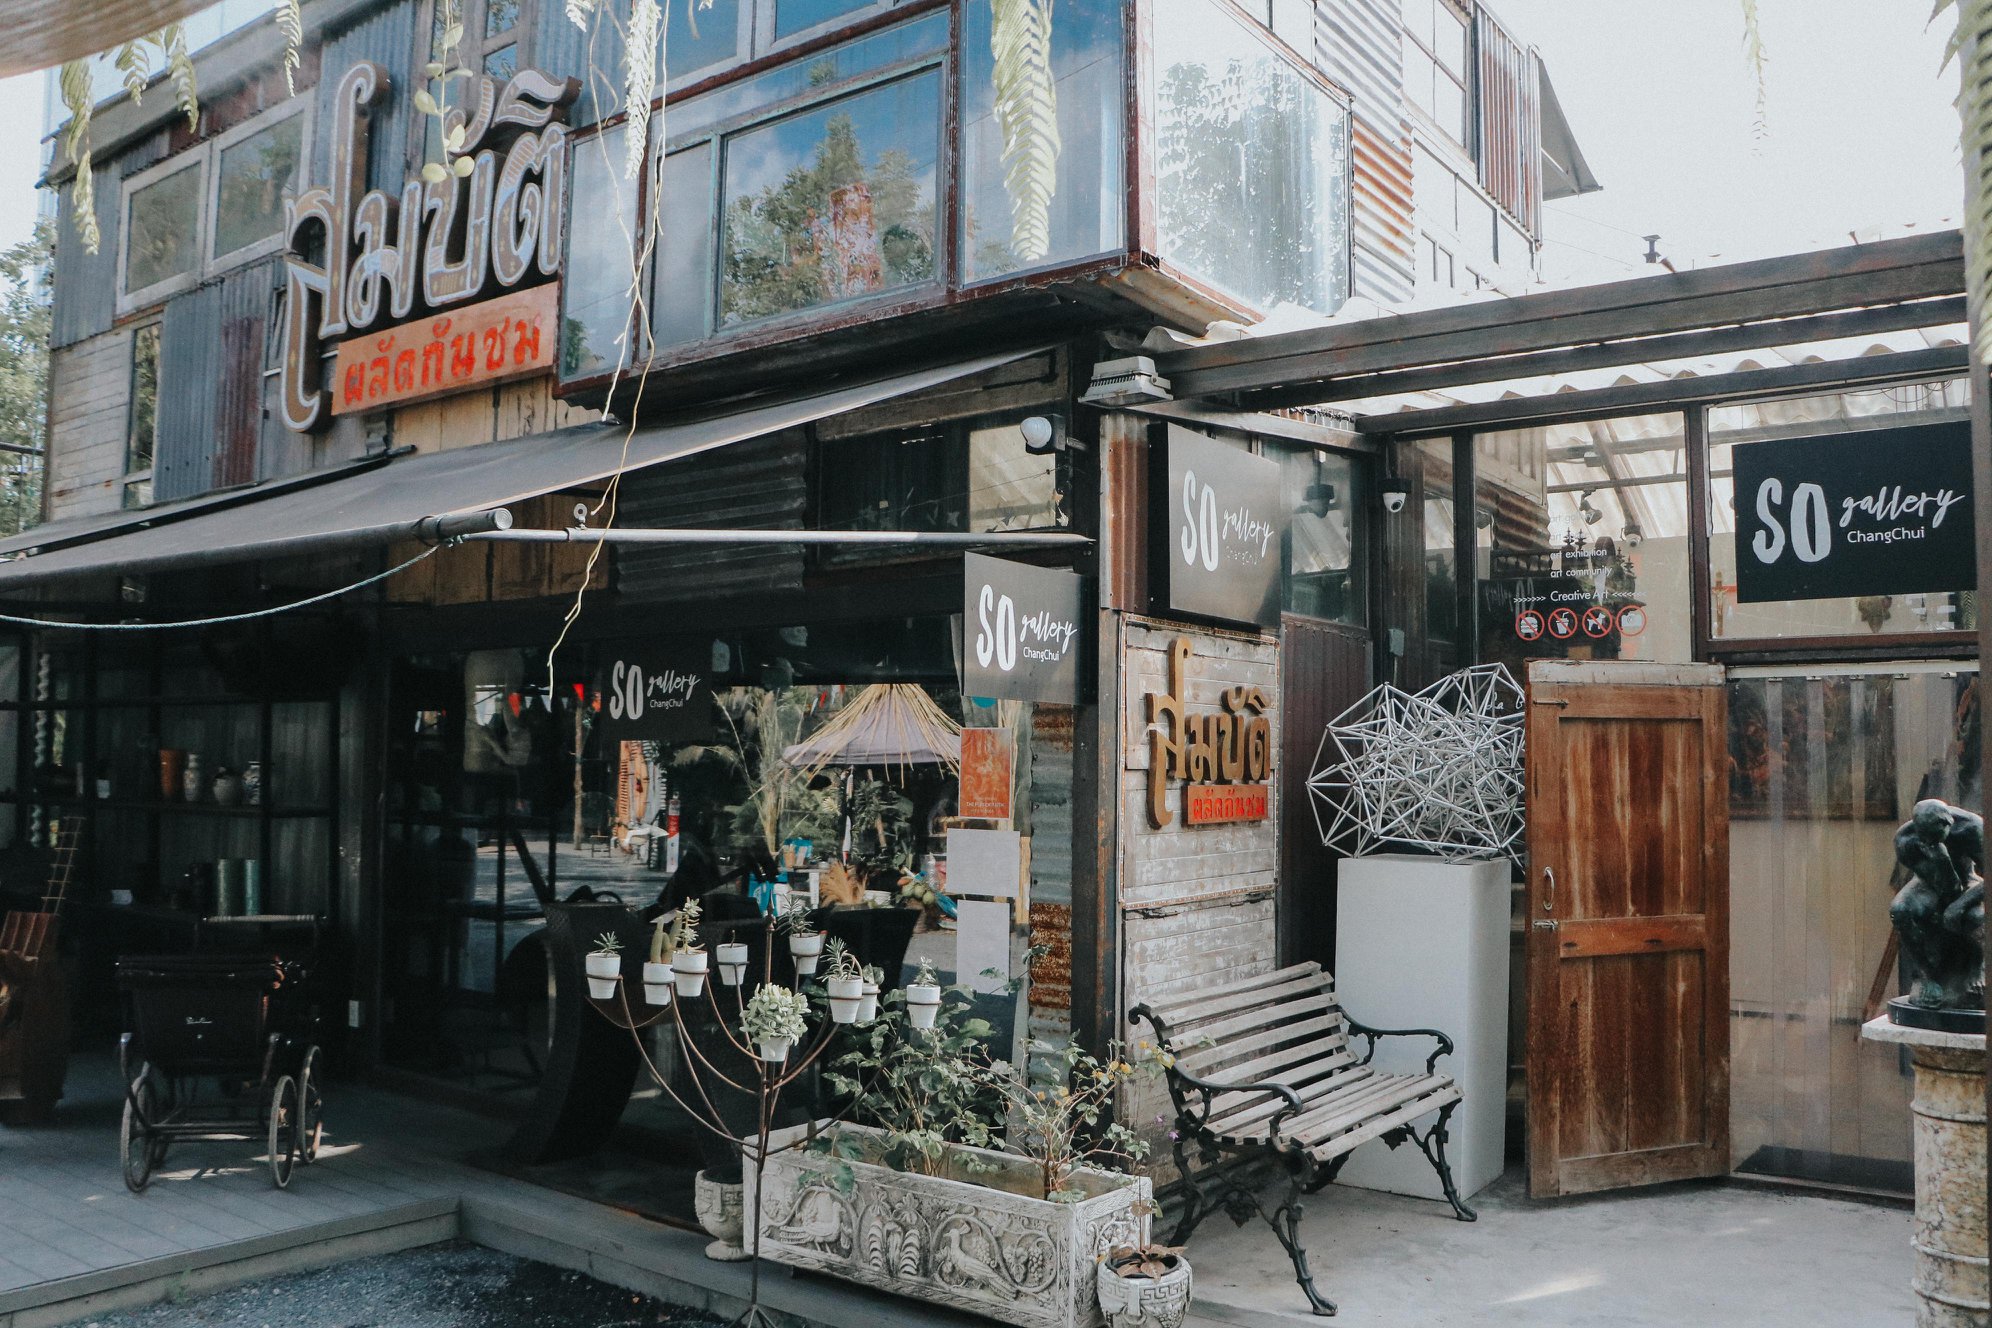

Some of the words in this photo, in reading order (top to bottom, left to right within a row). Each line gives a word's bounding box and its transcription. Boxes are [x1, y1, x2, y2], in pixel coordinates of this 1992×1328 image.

[343, 315, 541, 406] ผลัดกันชม
[1181, 469, 1219, 572] SO
[1222, 506, 1275, 558] gallery
[1752, 477, 1832, 564] SO
[1839, 485, 1966, 528] gallery
[1847, 526, 1926, 544] ChangChui
[1550, 568, 1562, 578] art
[1566, 565, 1613, 578] community
[1550, 589, 1591, 602] Creative
[1592, 589, 1609, 599] Art
[976, 584, 1016, 671] SO
[1020, 610, 1078, 655] gallery
[1023, 646, 1060, 662] ChangChui
[609, 660, 644, 720] SO
[646, 669, 701, 701] gallery
[649, 699, 684, 710] ChangChui
[1192, 788, 1265, 820] ผลัดกันชม
